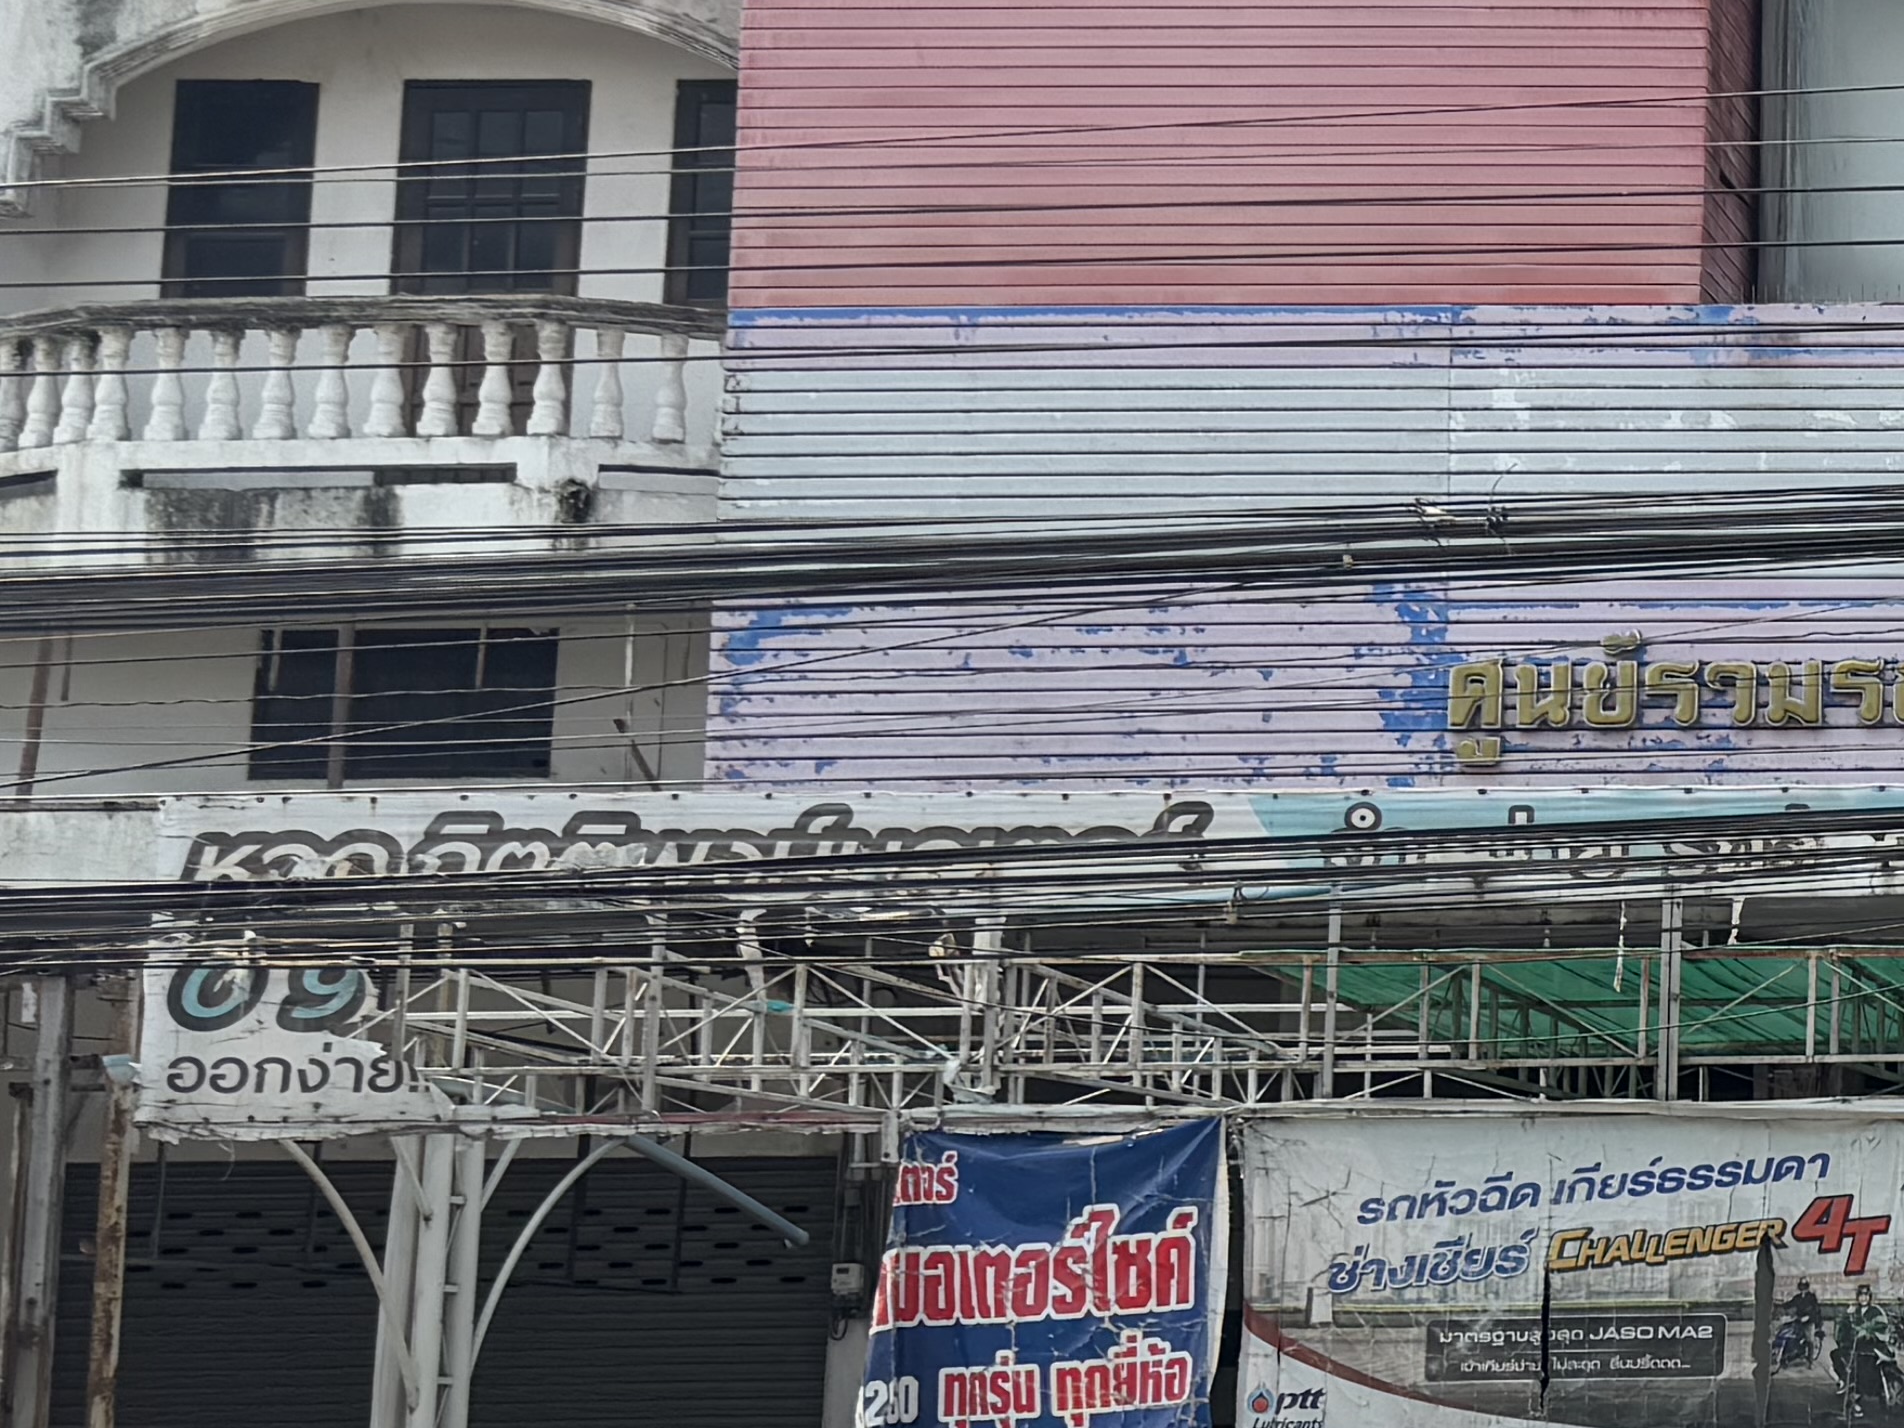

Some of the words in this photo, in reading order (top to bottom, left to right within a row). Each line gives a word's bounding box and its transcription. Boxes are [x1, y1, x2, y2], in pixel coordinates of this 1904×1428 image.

[1357, 1171, 1540, 1226] รถหัวฉีด
[1550, 1152, 1831, 1206] เกียร์ธรรมดา
[1327, 1227, 1539, 1294] ช่างเชียร์
[1547, 1217, 1789, 1273] CHALLENGER
[1792, 1193, 1892, 1276] 4T
[1589, 1327, 1652, 1341] JASO
[1658, 1326, 1714, 1340] MA2
[1275, 1387, 1326, 1414] ptt
